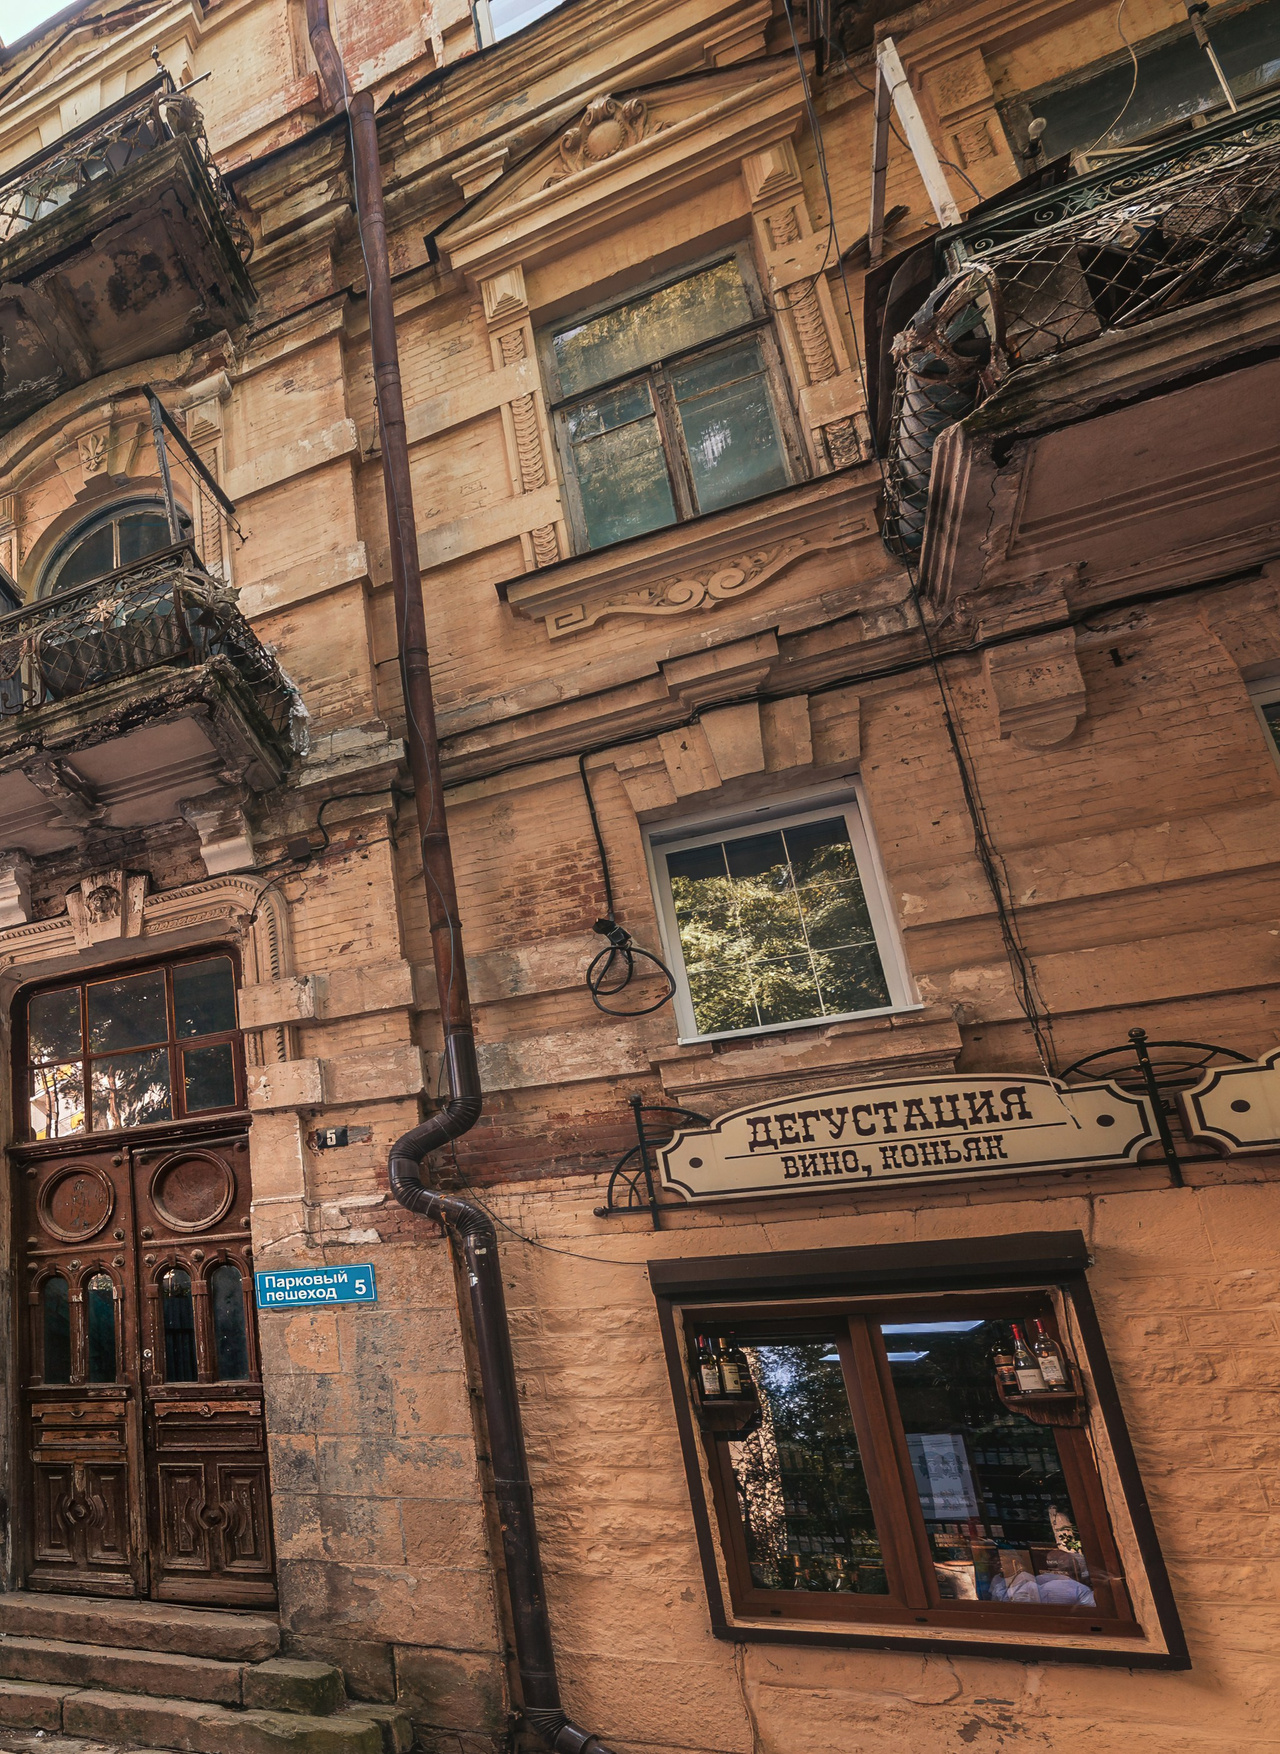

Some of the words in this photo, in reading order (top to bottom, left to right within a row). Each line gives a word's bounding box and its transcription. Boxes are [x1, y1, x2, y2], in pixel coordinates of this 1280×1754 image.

[746, 1085, 1033, 1152] ДЕГУСТАЦИЯ
[326, 1129, 337, 1146] 5
[780, 1149, 873, 1178] ВИНО,
[878, 1134, 1008, 1170] КОНЬЯК
[264, 1270, 349, 1290] Парковый
[354, 1279, 367, 1296] 5
[265, 1288, 338, 1302] пешеход
